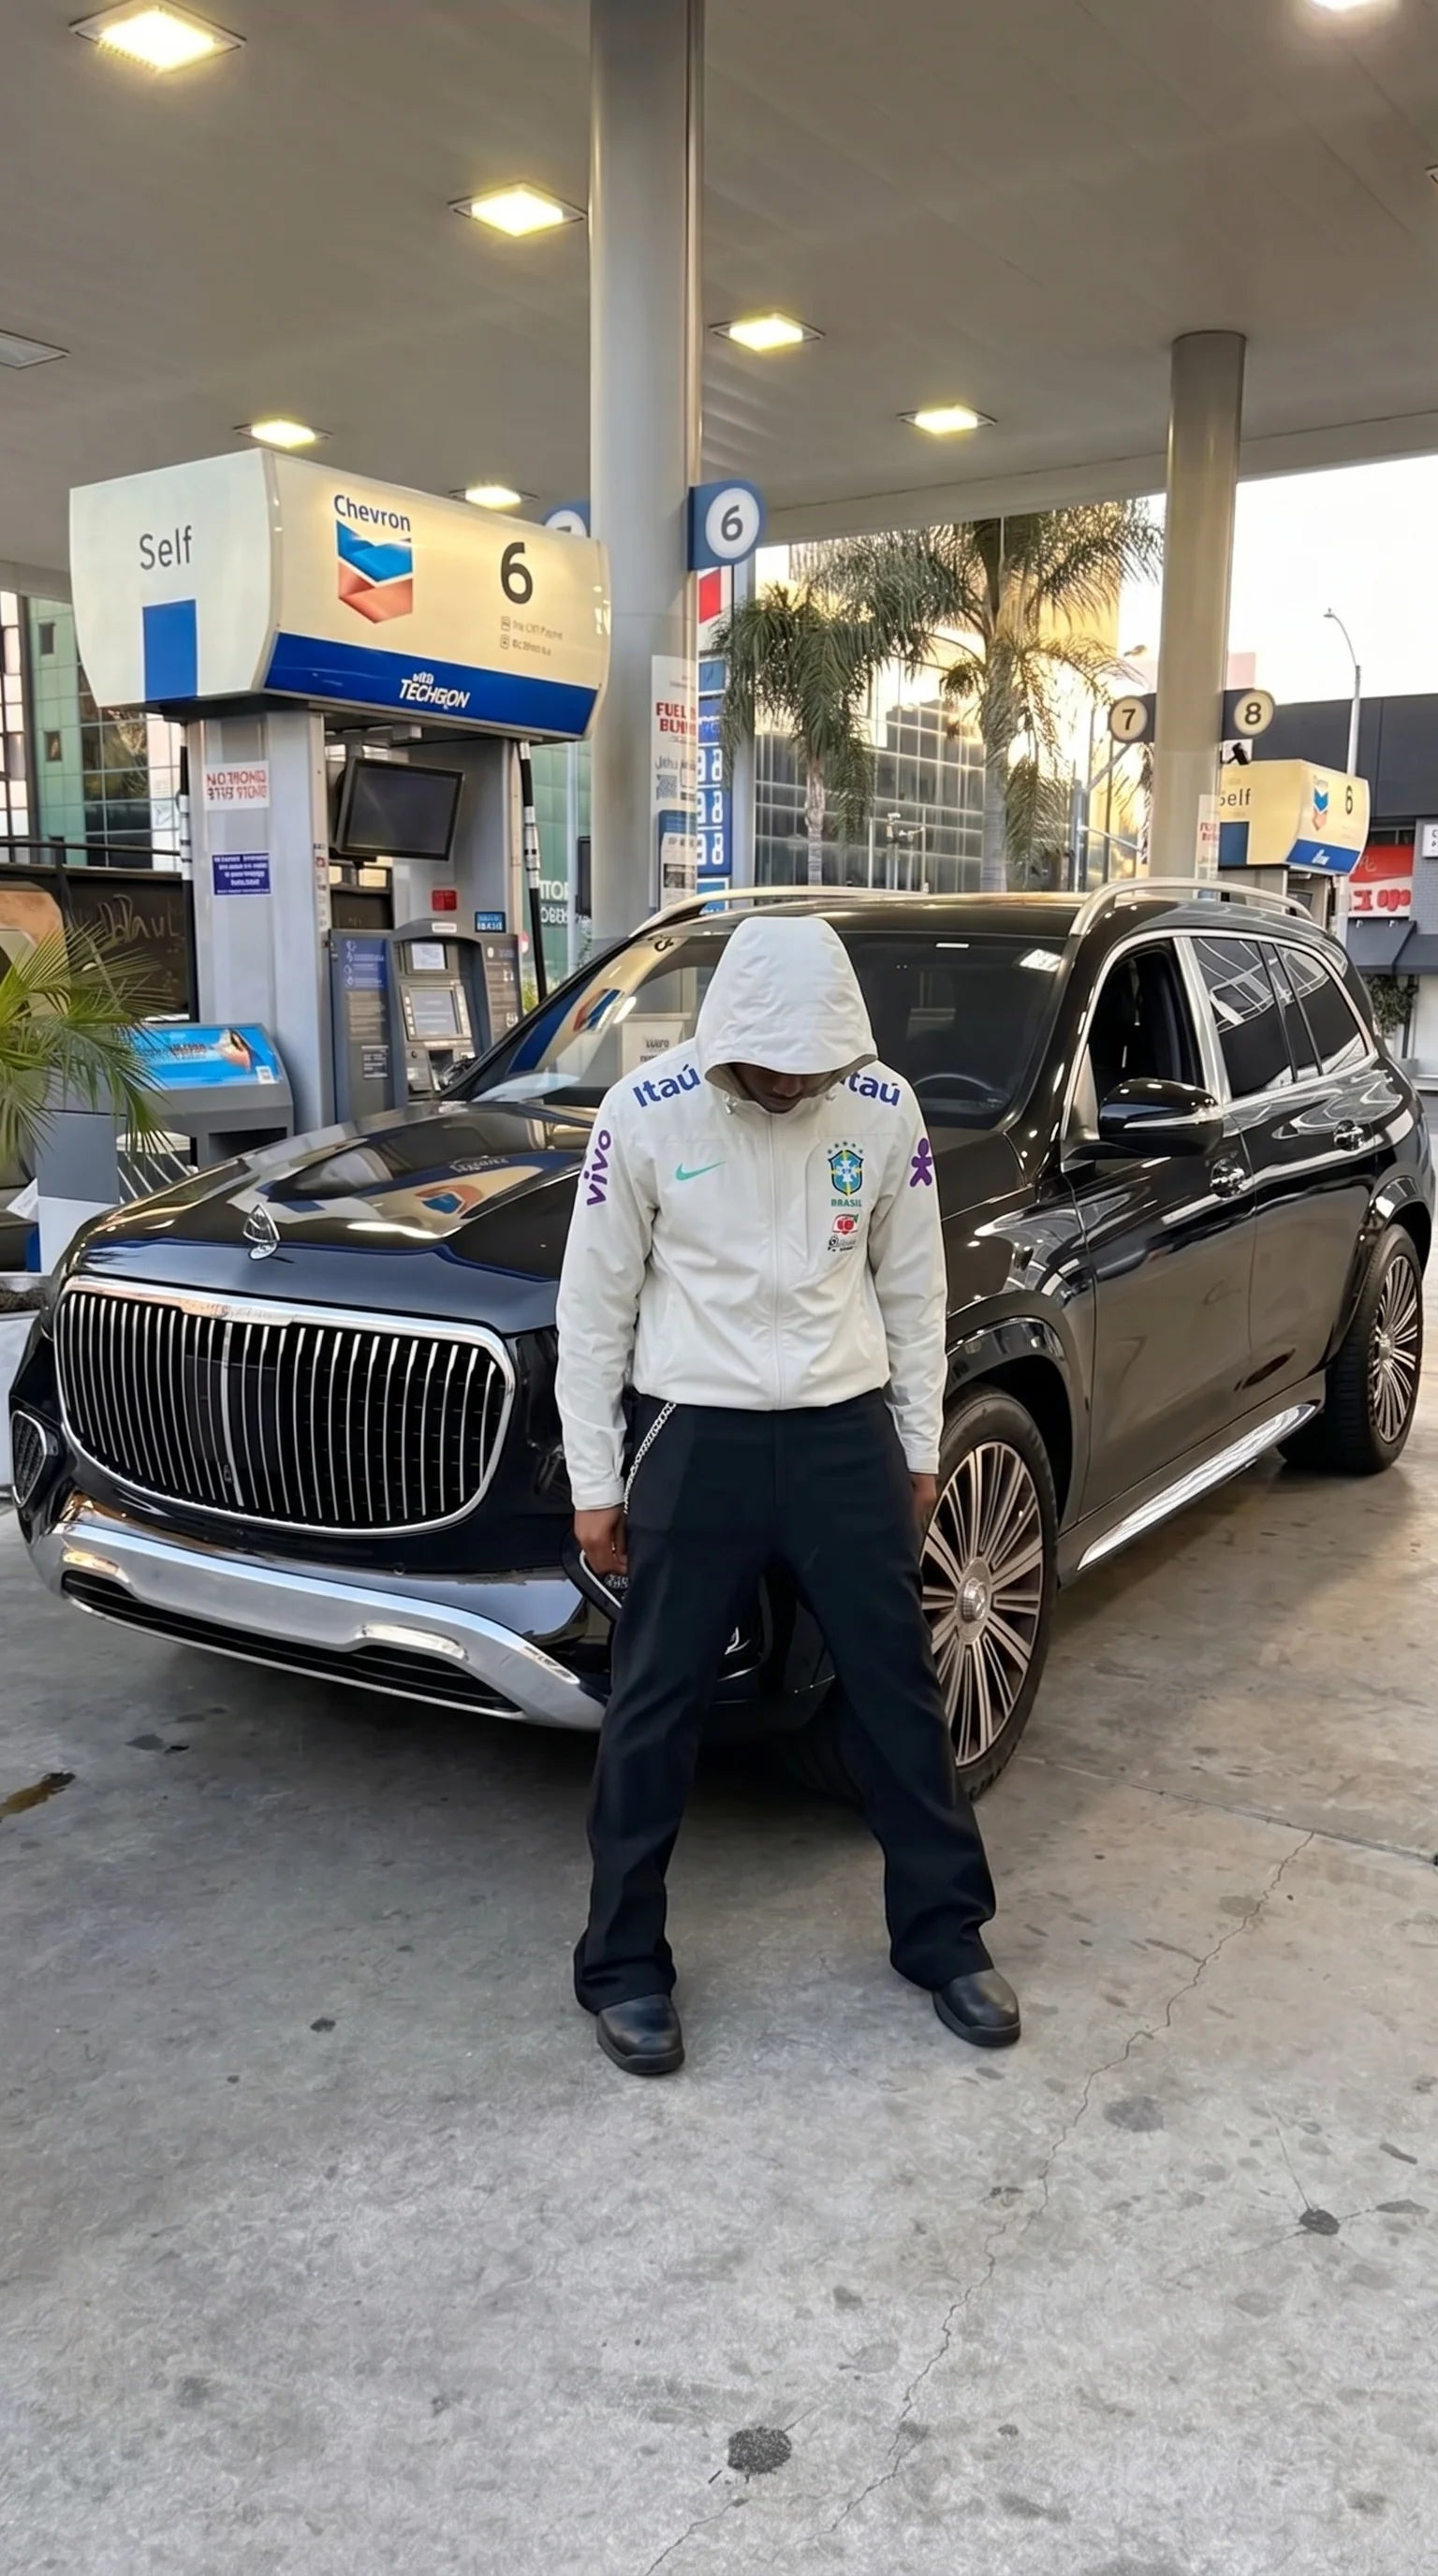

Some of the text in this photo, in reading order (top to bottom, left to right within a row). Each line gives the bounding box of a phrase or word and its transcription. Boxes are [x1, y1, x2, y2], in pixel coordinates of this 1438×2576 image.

[333, 494, 411, 532] Chevron
[720, 505, 743, 542] 6
[139, 524, 192, 571] Self
[500, 541, 533, 605] 6
[656, 702, 686, 719] FUEL
[1123, 709, 1136, 730] 7
[1244, 702, 1262, 724] 8
[1345, 785, 1353, 815] 6
[632, 1063, 701, 1107] Itaú
[840, 1071, 901, 1106] taú
[586, 1129, 611, 1207] vivo
[830, 1199, 862, 1208] BRASIL
